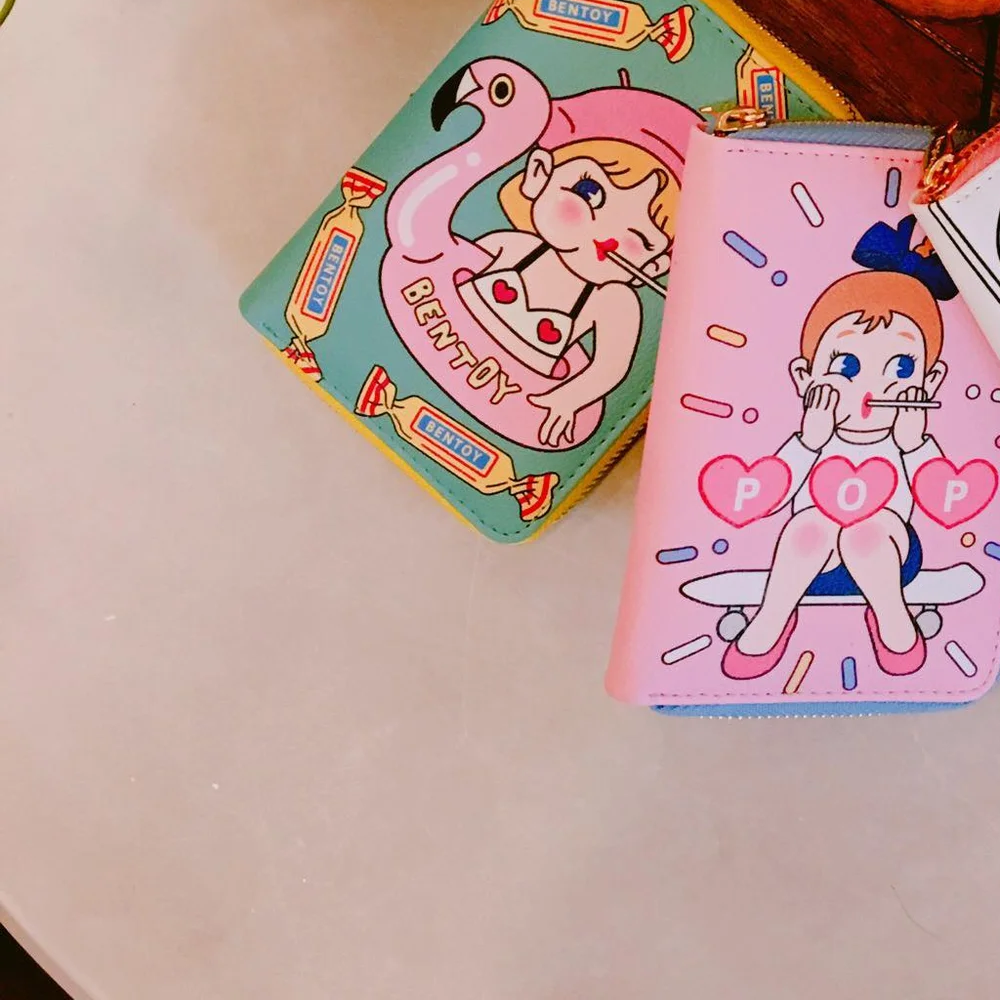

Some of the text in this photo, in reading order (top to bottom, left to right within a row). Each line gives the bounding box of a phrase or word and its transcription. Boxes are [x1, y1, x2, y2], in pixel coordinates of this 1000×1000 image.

[312, 243, 344, 308] BENTOY
[401, 276, 522, 405] BENTOY
[424, 420, 484, 463] BENTOY
